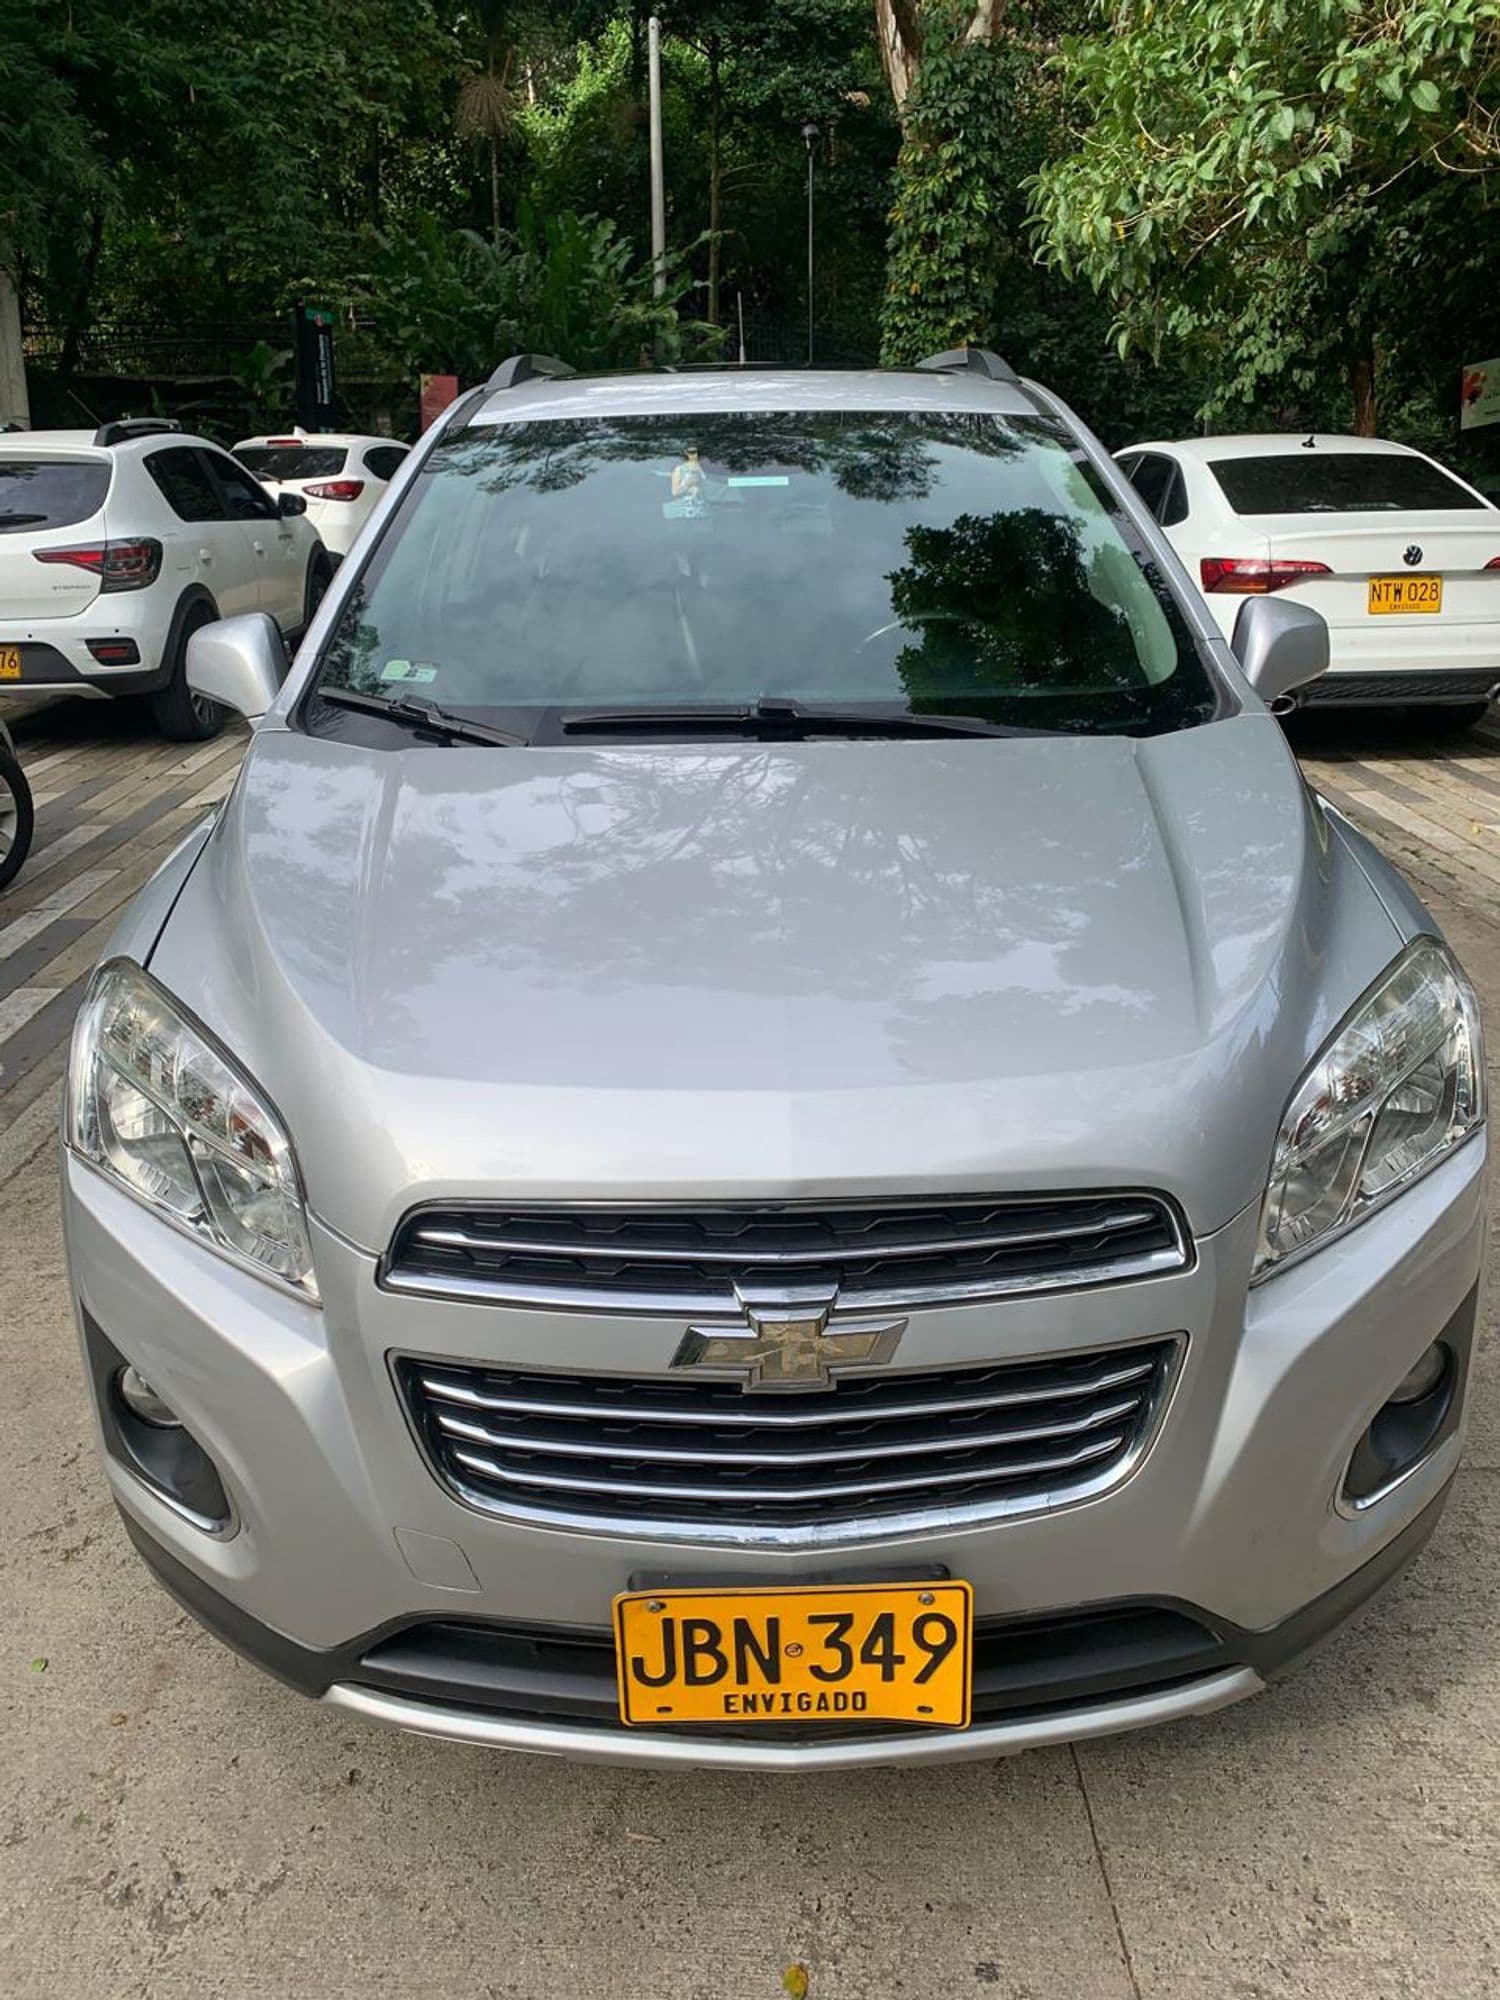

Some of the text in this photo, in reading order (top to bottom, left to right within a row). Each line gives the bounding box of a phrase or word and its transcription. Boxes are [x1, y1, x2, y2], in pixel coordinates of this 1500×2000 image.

[1371, 582, 1439, 602] NTW 028
[0, 651, 17, 669] 76
[632, 1613, 957, 1687] JBN 349
[724, 1691, 867, 1714] ENVIGADO
